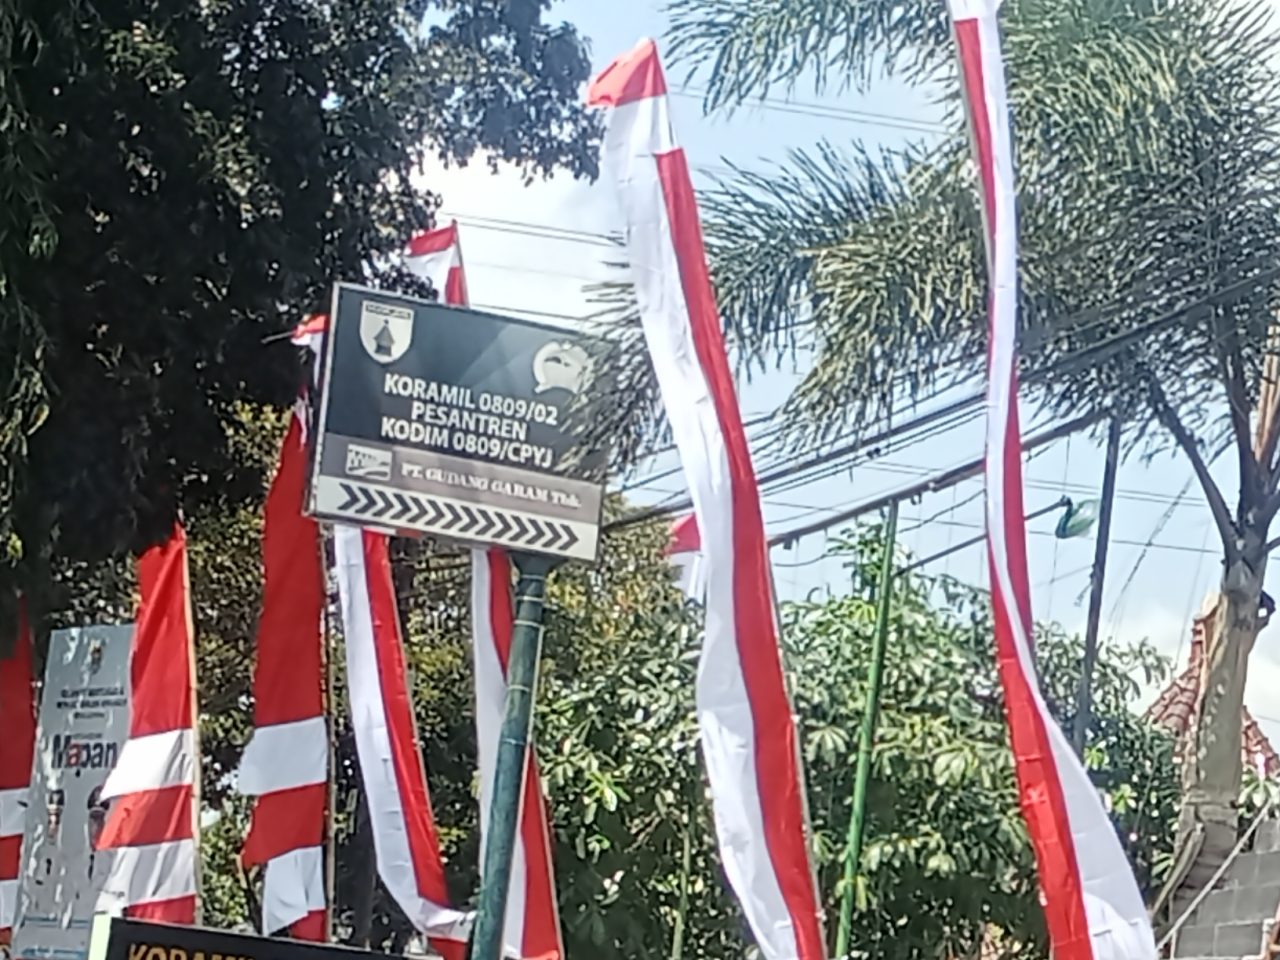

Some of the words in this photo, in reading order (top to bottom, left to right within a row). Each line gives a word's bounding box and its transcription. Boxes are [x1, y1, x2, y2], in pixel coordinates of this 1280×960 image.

[384, 373, 475, 410] KORAMIL
[479, 394, 558, 426] 0809/02
[411, 402, 527, 441] PESANTREN
[381, 417, 449, 449] KODIM
[452, 431, 553, 468] 0809/CPYJ
[401, 462, 424, 478] PT.
[426, 467, 490, 492] GUDANG
[491, 480, 549, 502] GARAM
